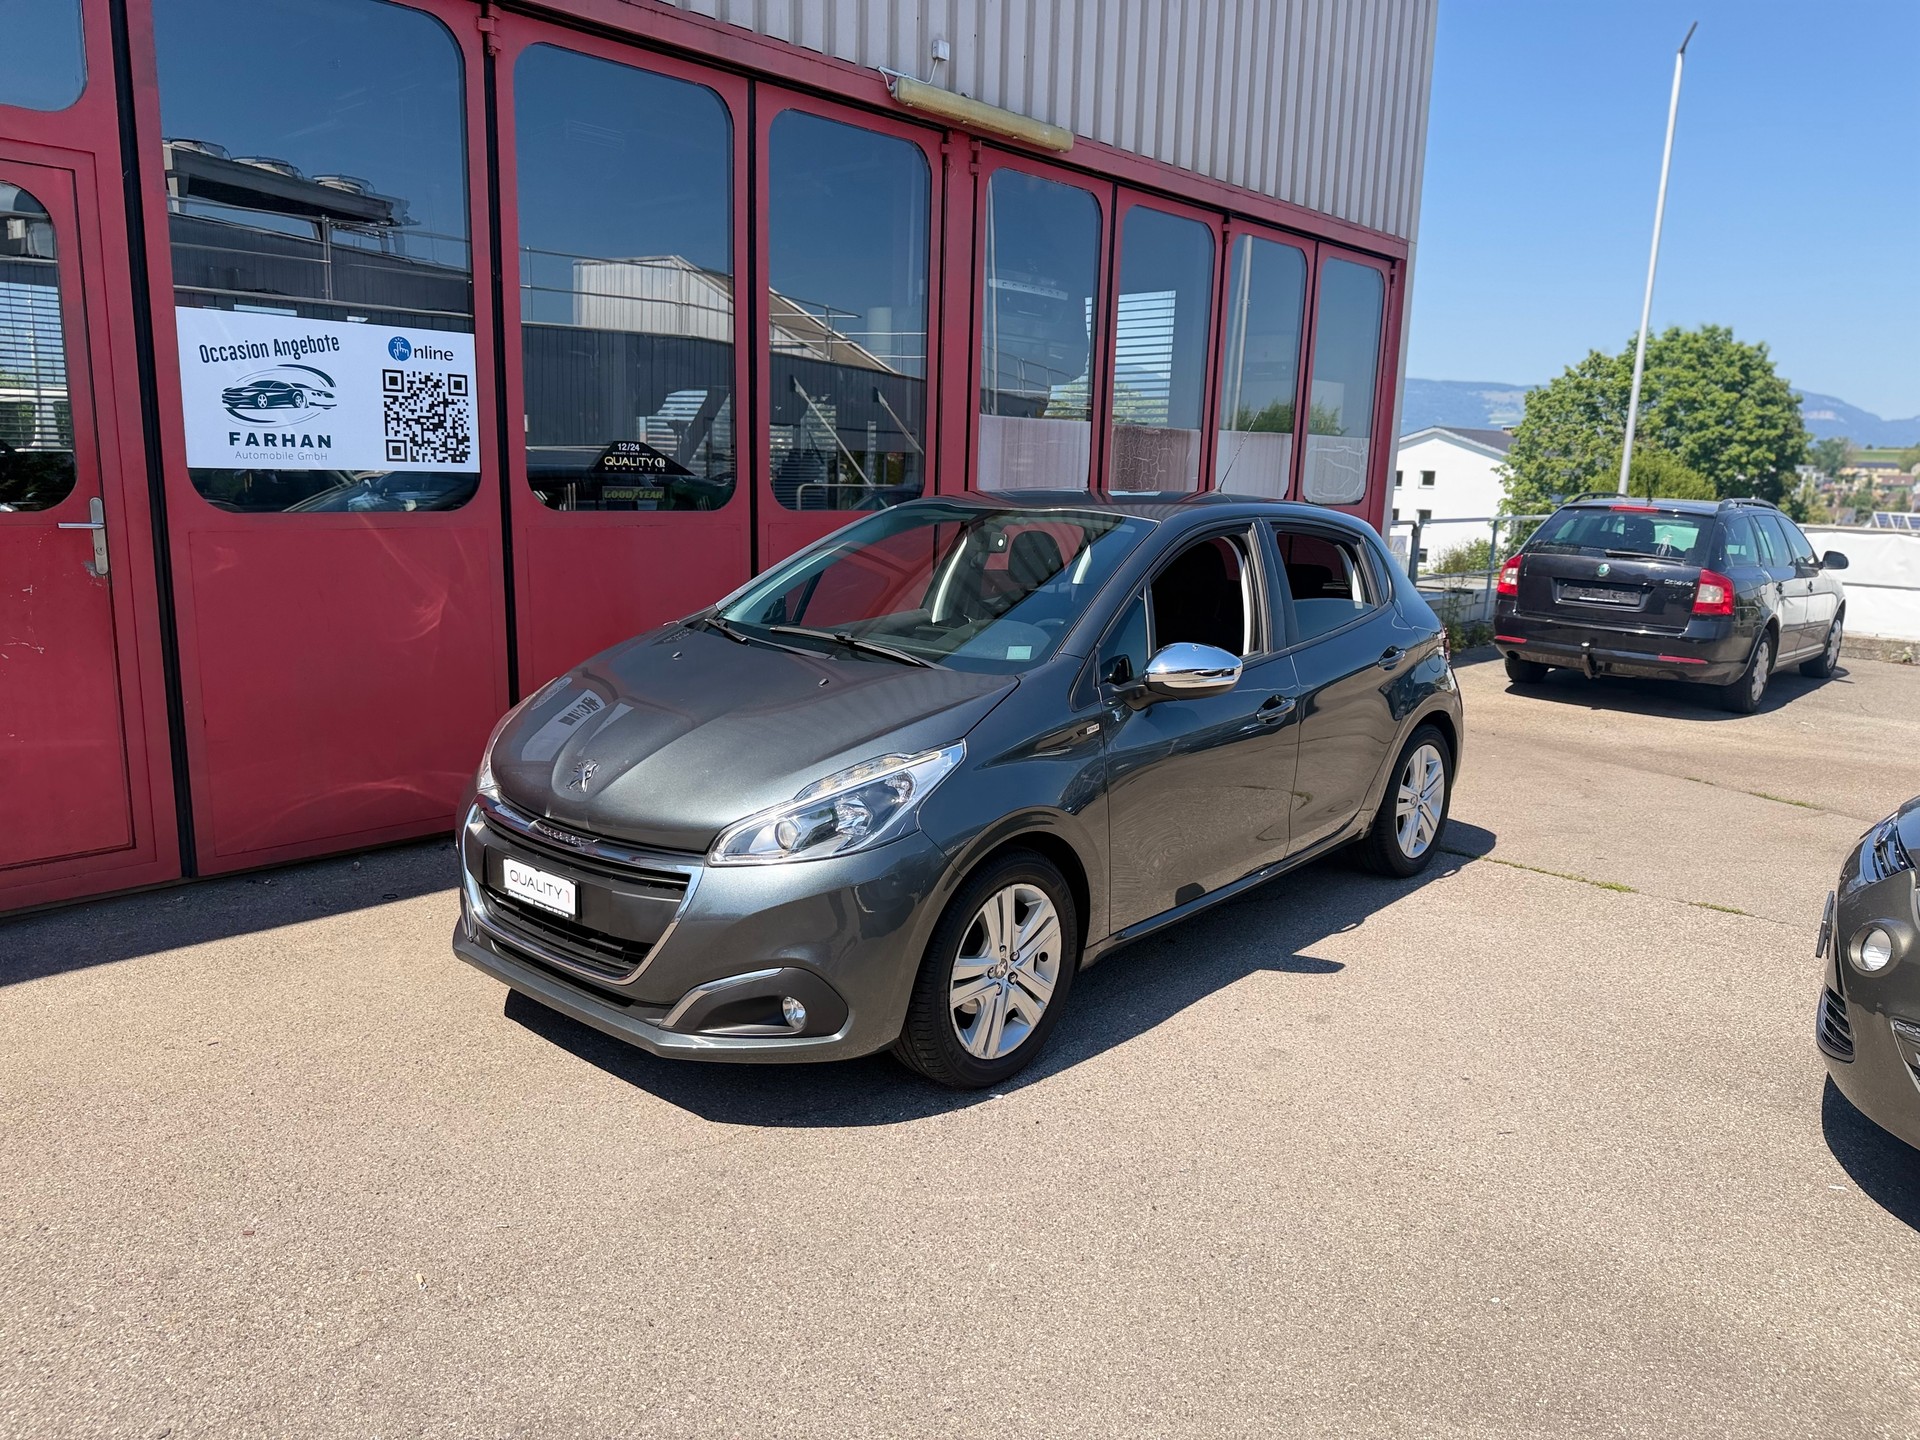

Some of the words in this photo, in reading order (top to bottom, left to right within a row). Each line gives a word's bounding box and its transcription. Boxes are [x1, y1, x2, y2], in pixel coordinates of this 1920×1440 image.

[199, 340, 270, 363] Occasion
[273, 334, 340, 360] Angebote
[228, 432, 332, 448] FARHAN
[617, 442, 640, 452] 12/24
[235, 450, 294, 461] Automobile
[297, 452, 328, 461] GmbH
[604, 456, 654, 467] QUALITY
[509, 869, 563, 899] QUALITY
